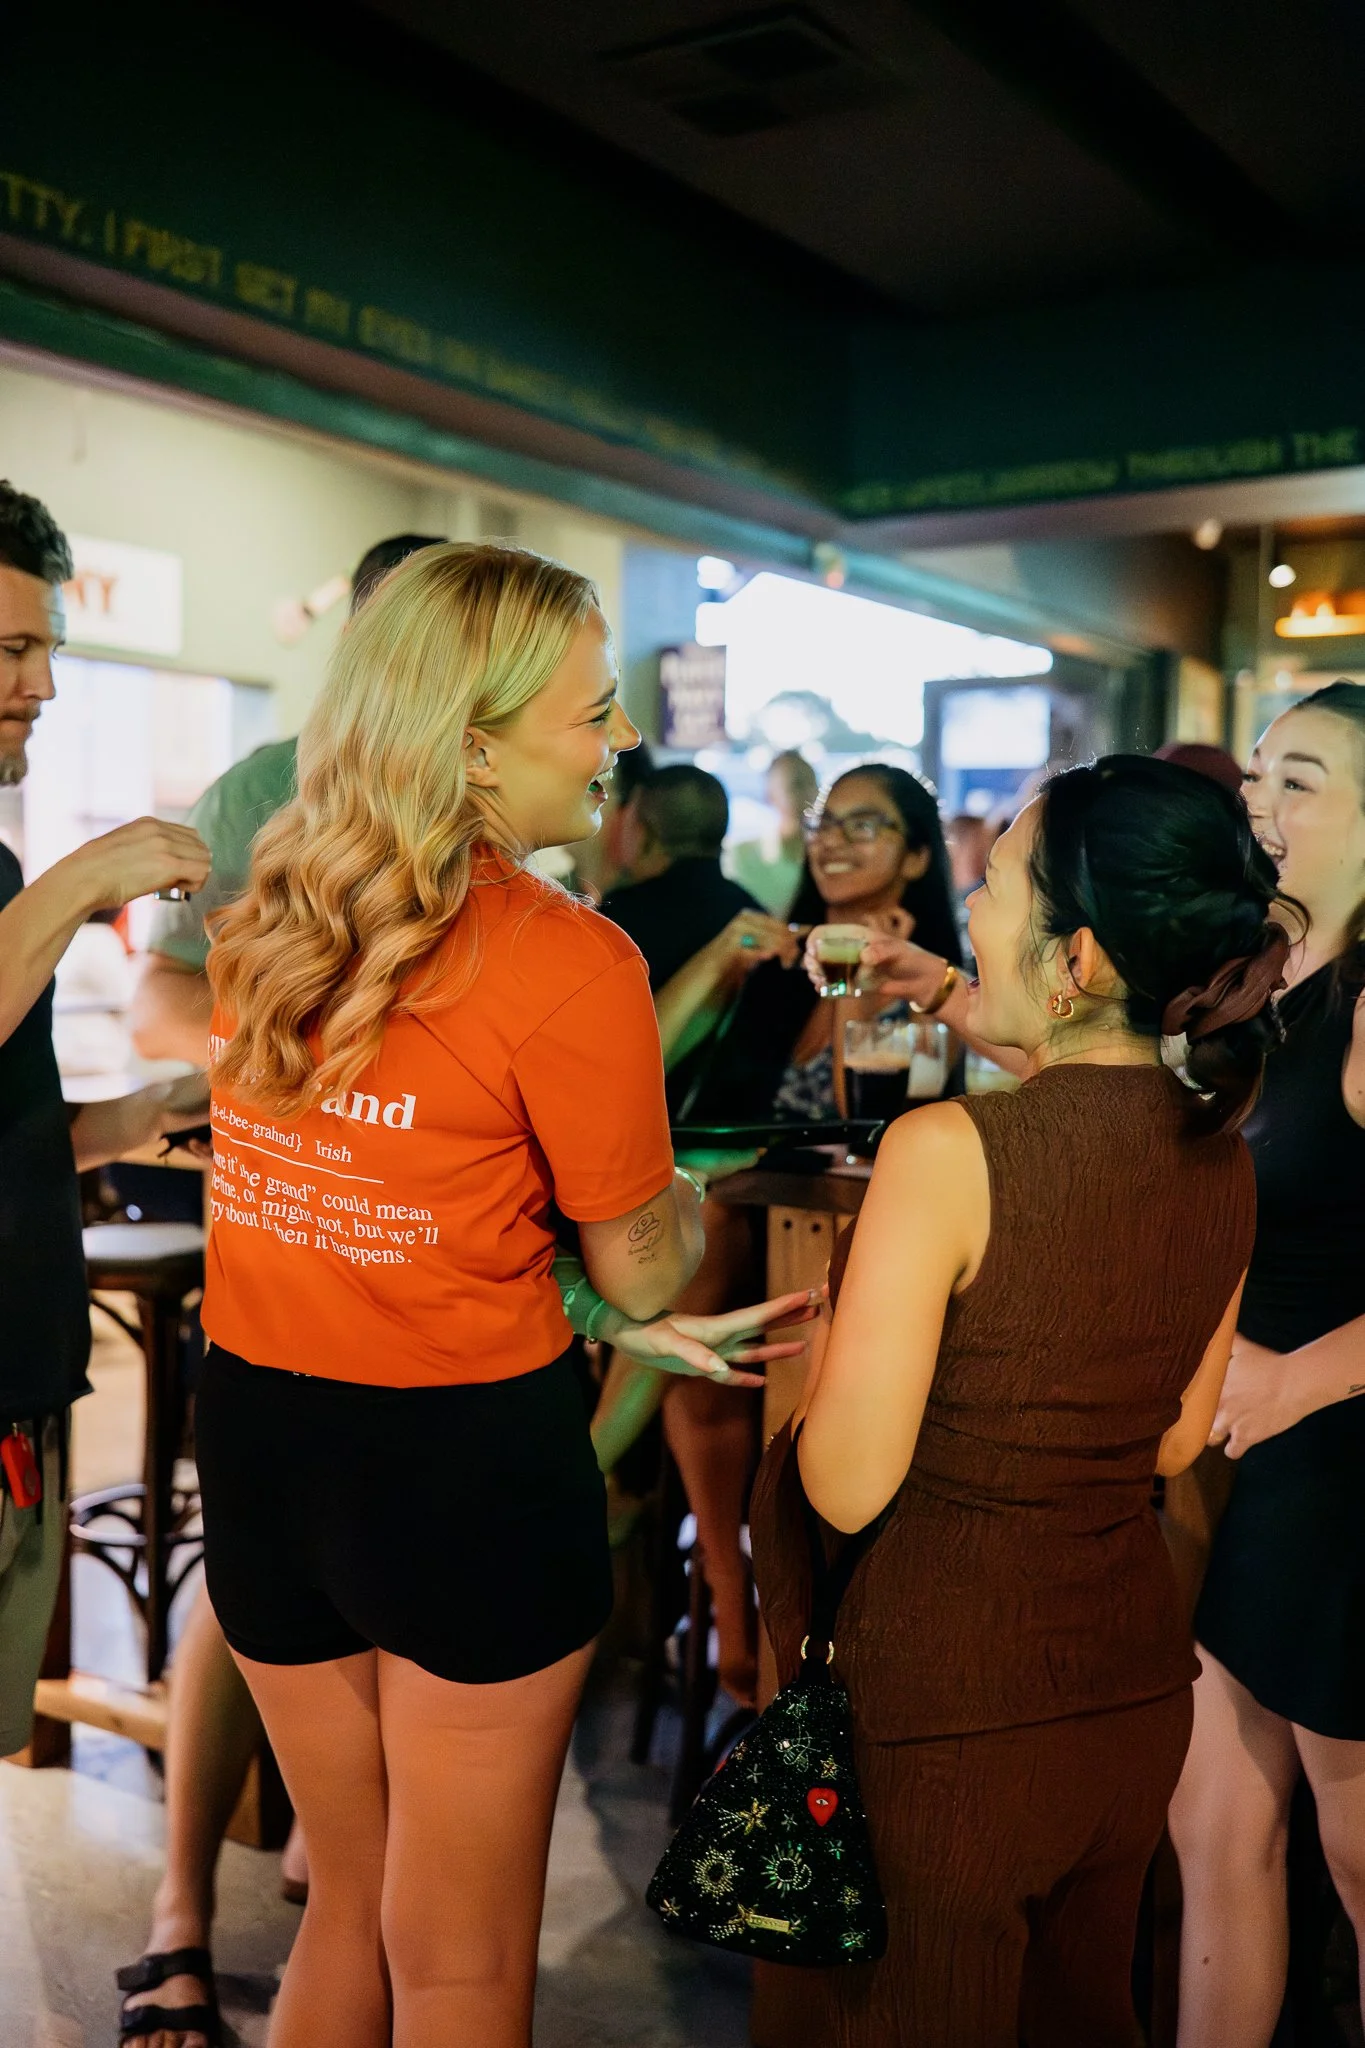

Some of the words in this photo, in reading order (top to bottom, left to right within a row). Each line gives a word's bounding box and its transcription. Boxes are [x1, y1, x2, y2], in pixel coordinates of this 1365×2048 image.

[315, 1140, 352, 1163] Irish
[261, 1198, 314, 1224] might
[316, 1215, 349, 1238] not,
[353, 1217, 385, 1239] but
[322, 1193, 371, 1216] could
[375, 1204, 434, 1221] mean
[314, 1229, 328, 1250] it
[329, 1236, 412, 1267] happens.
